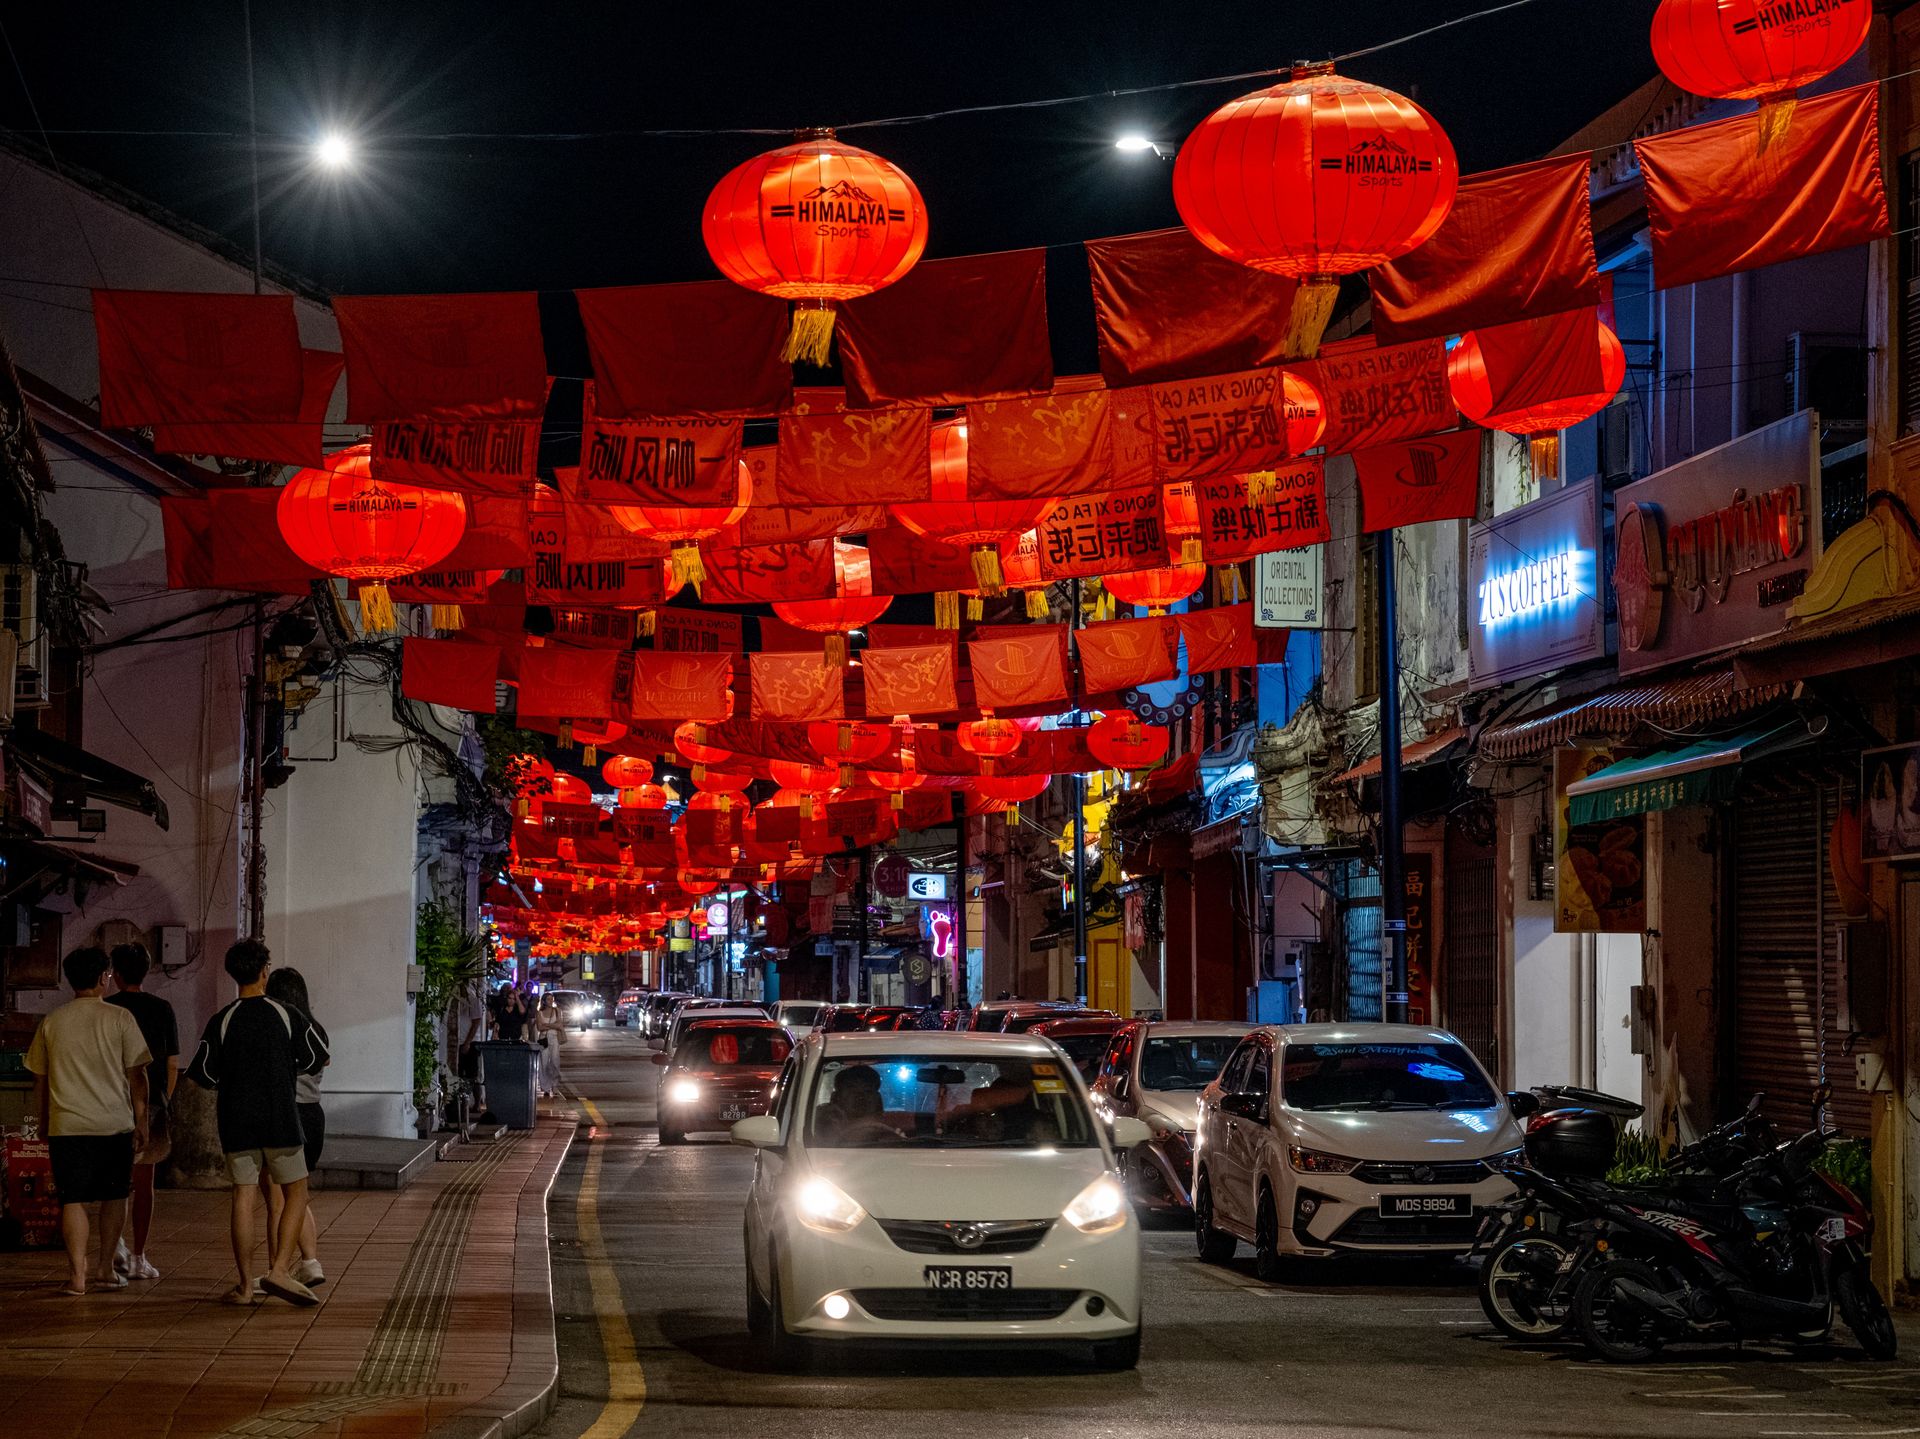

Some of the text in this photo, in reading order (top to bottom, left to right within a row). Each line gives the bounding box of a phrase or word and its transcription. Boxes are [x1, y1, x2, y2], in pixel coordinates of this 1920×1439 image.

[1781, 17, 1833, 39] Sports
[1345, 154, 1418, 175] HIMALAYA
[1358, 174, 1403, 191] Sports
[798, 200, 886, 226] HIMALAYA
[814, 224, 872, 242] Sports
[349, 500, 402, 513] HIMALAYA
[1271, 561, 1307, 580] ORIENTAL
[1264, 587, 1313, 606] COLLECTIONS
[1478, 552, 1571, 625] ZUS COFFEE
[729, 1104, 739, 1112] SA
[1396, 1199, 1456, 1212] MDS 9894
[1636, 1210, 1717, 1241] STREET
[928, 1270, 1009, 1289] NCR 8573
